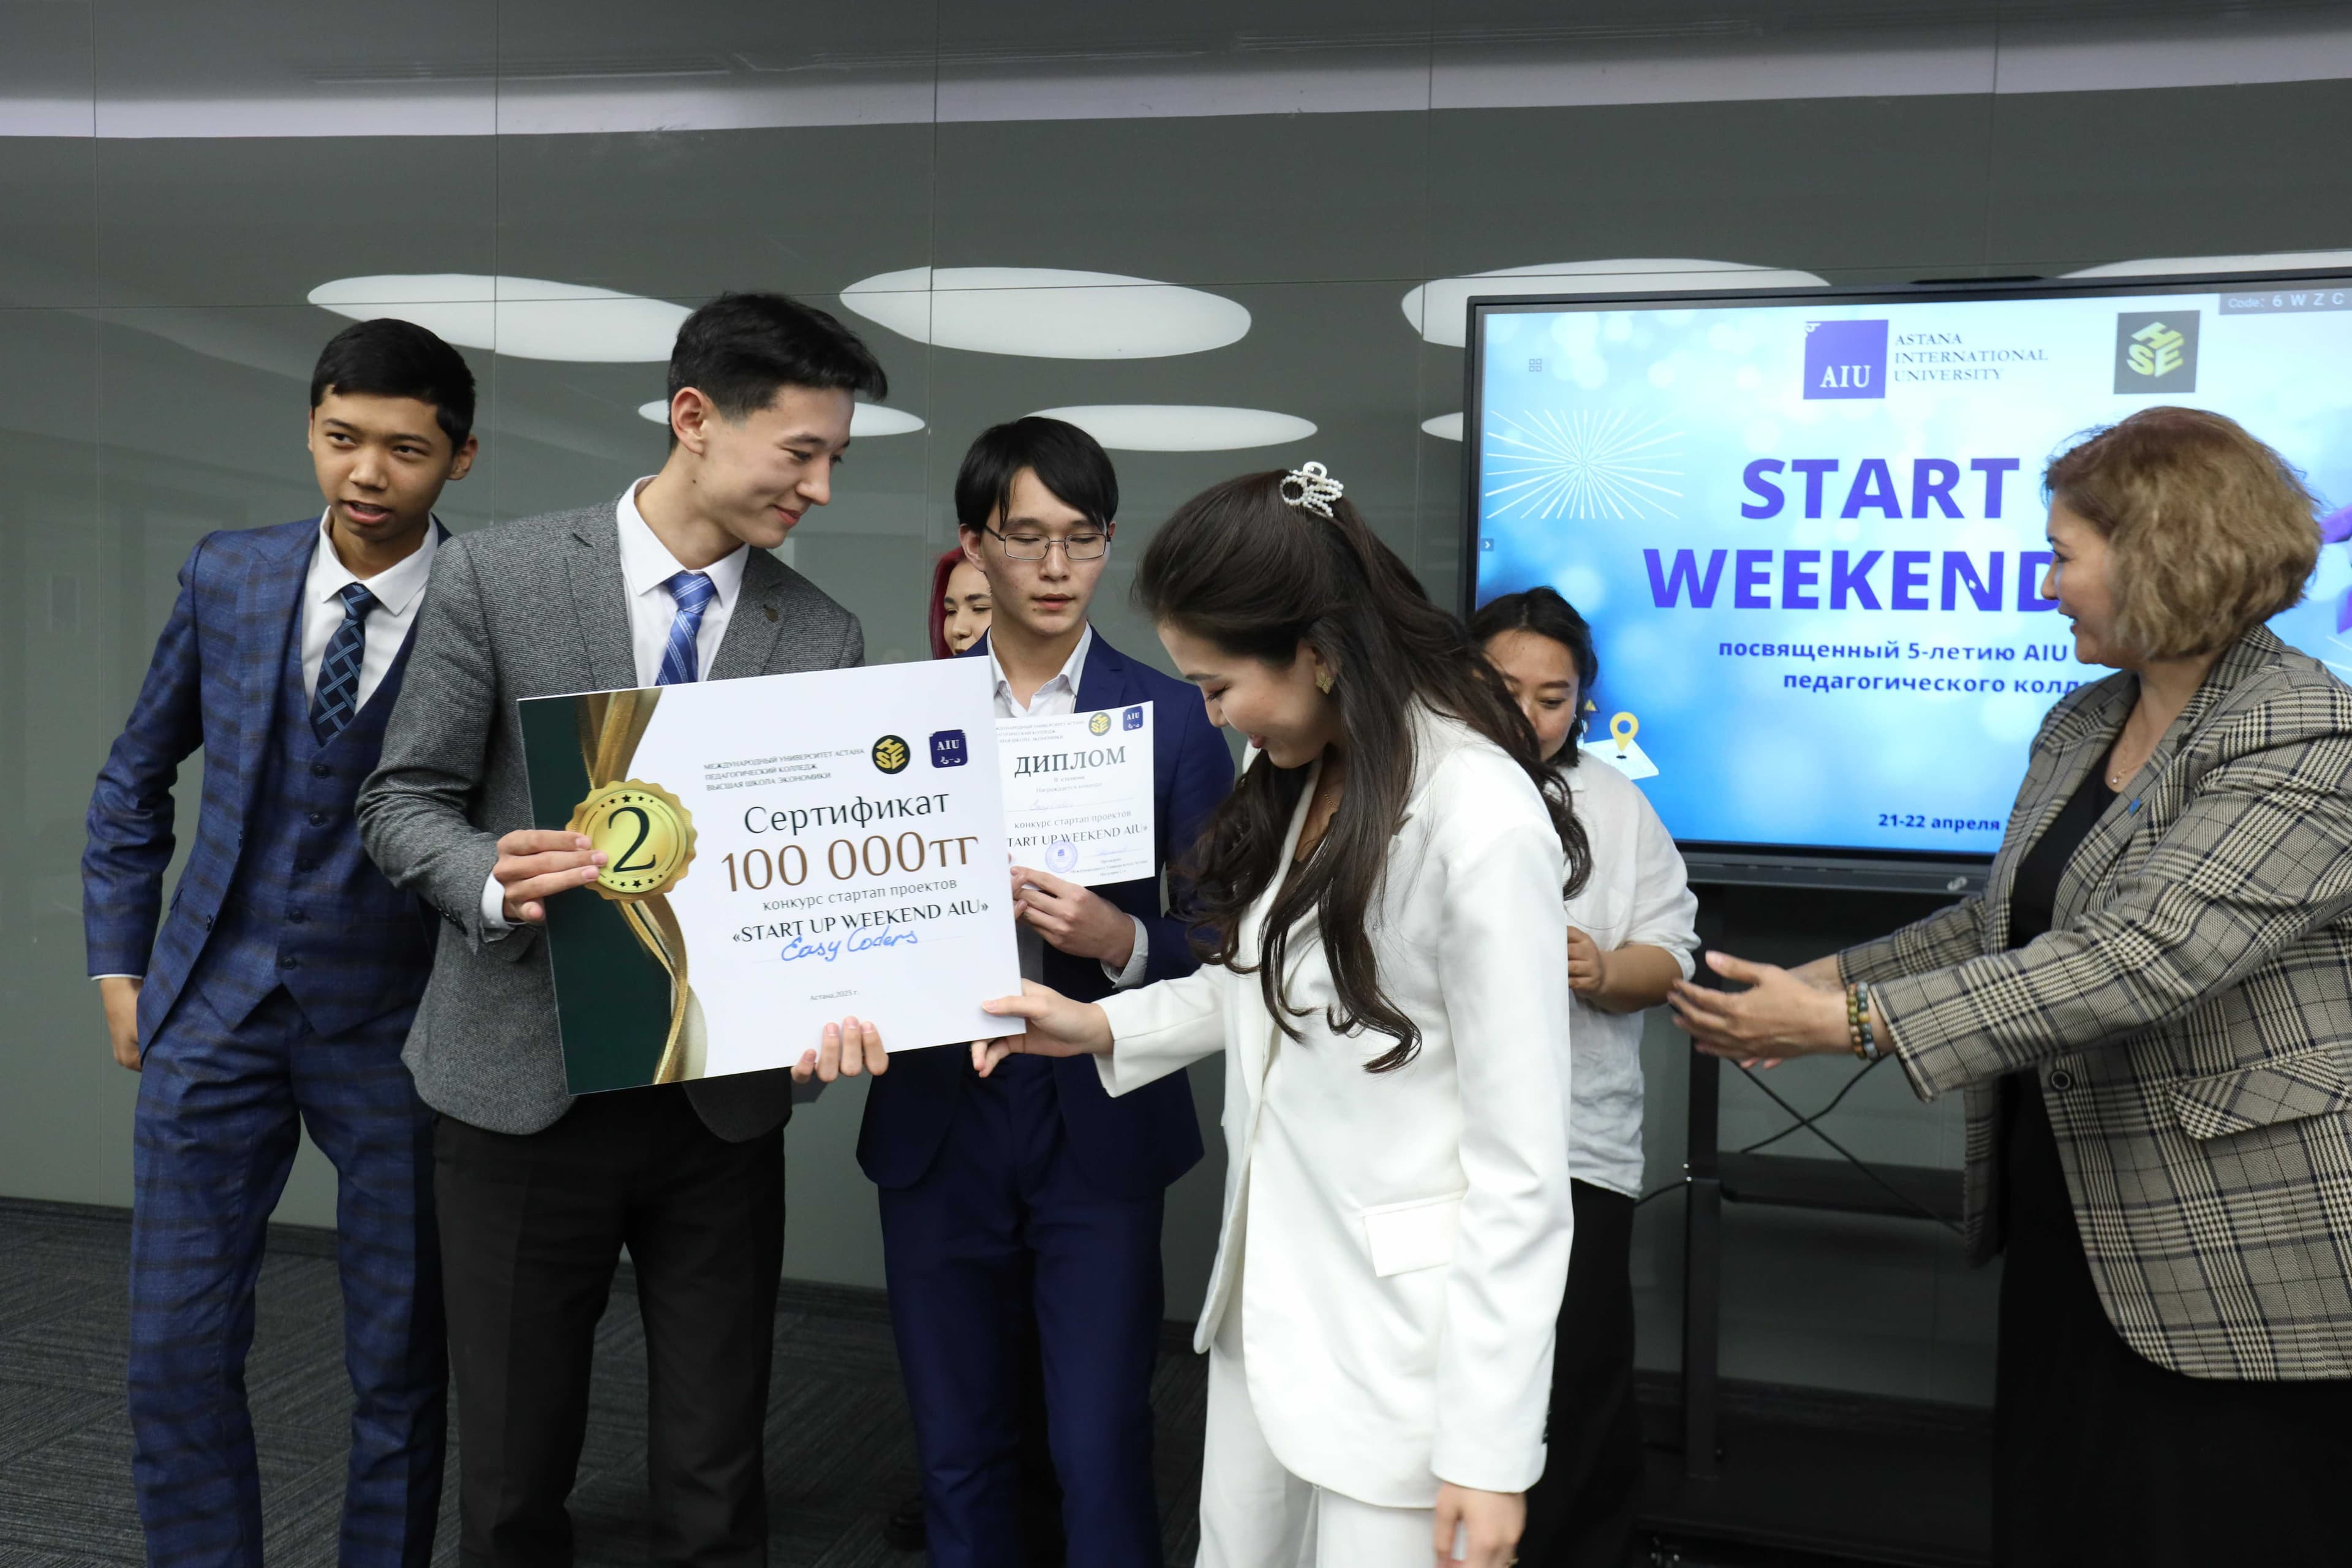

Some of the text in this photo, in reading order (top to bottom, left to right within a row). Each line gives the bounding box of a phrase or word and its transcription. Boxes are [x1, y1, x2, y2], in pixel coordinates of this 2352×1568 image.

[2228, 298, 2266, 308] Code:
[1896, 333, 1962, 345] ASTANA
[1895, 349, 2048, 364] INTERNATIONAL
[1820, 365, 1871, 388] AIU
[1894, 368, 2003, 382] UNIVERSITY
[1740, 458, 2020, 519] START
[1643, 549, 2057, 612] WEEKEND
[1719, 641, 2067, 661] посвященный 5-летию AIU
[1784, 673, 2079, 695] педагогического колл
[937, 739, 960, 750] AIU
[704, 748, 864, 770] МЕЖДУНАРОДНЫЙ УНИВЕРСИТЕТ АСТАНА
[1014, 746, 1126, 778] ДИПЛОМ
[705, 763, 818, 780] ПЕДАГОГИЧЕСКИЙ КОЛЛЕДЖ
[706, 772, 831, 791] ВЫСШАЯ ШКОЛА ЭКОНОМИКИ
[744, 793, 949, 835] Сертификат
[1014, 810, 1132, 829] конкурс стартап проектов
[1879, 813, 2000, 832] 21-22 апреля
[608, 807, 655, 872] 2
[1007, 835, 1038, 847] TART
[1042, 834, 1058, 845] UP
[1061, 827, 1120, 843] WEEKEND
[722, 845, 807, 891] 100
[763, 879, 957, 913] конкурс стартап проектов
[733, 900, 989, 943] «START UP WEEKEND AIU»
[781, 925, 918, 962] Easy Coders
